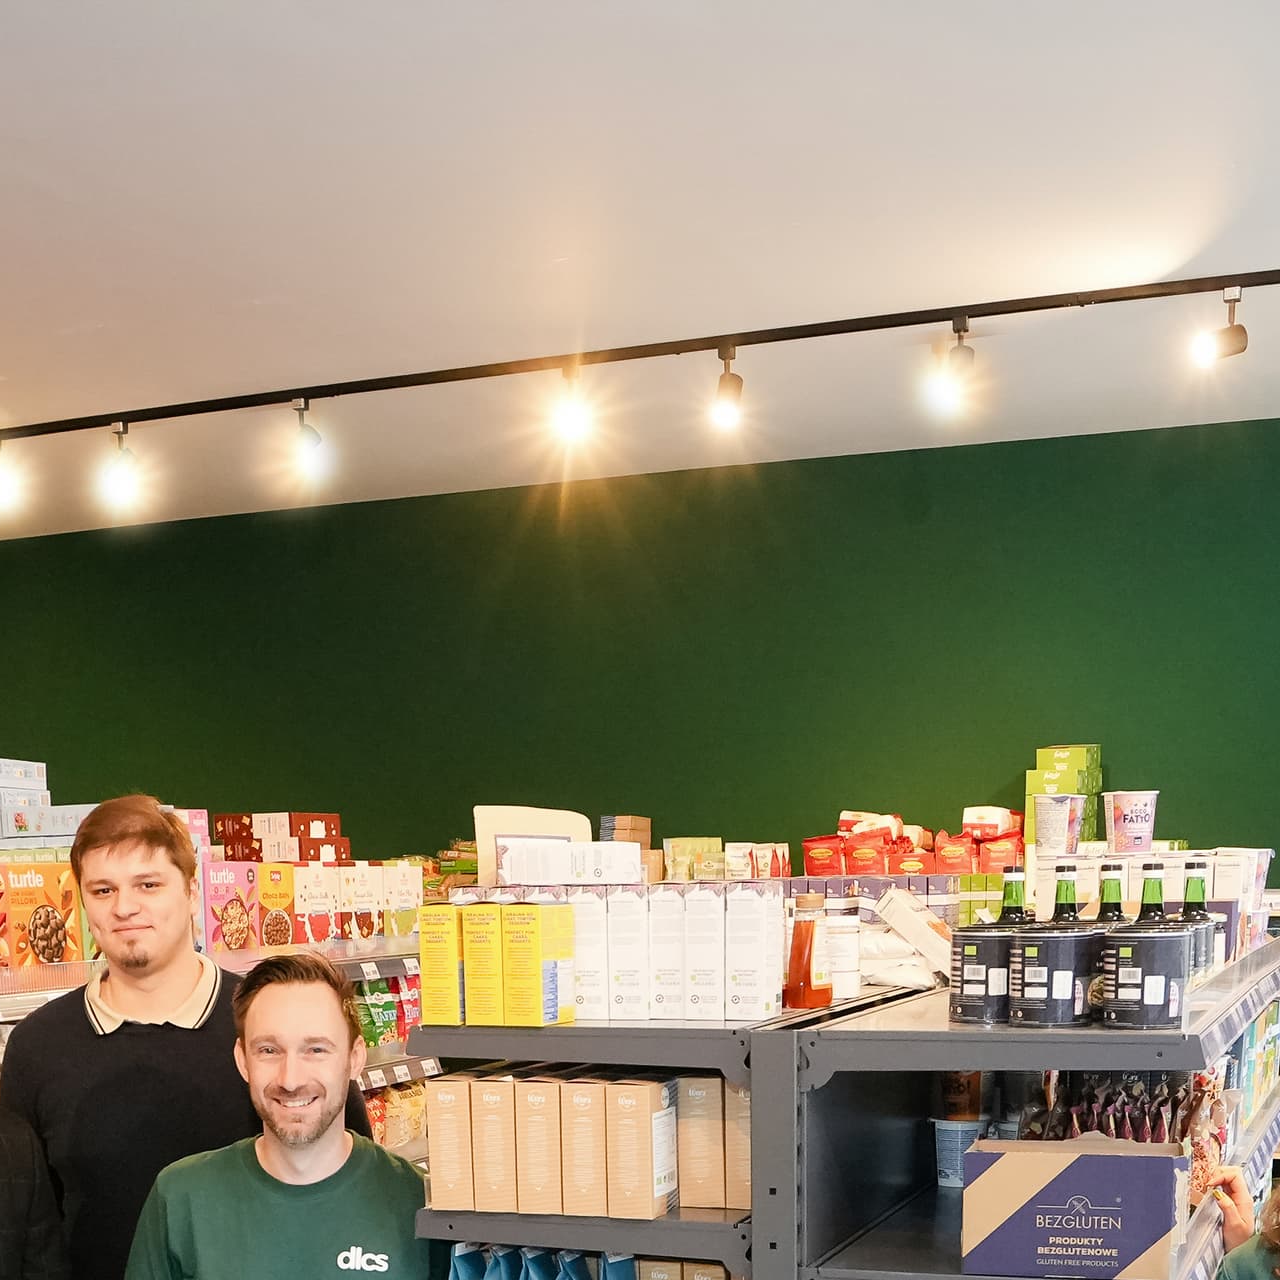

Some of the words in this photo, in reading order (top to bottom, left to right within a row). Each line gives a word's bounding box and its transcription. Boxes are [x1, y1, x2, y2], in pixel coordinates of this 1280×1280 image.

[8, 871, 44, 888] turtle
[210, 869, 235, 883] turtle
[1036, 1215, 1121, 1229] BEZGLUTEN
[1049, 1237, 1103, 1245] PRODUKTY
[1038, 1247, 1118, 1256] BEZGLUTENOWE
[337, 1246, 388, 1272] dlcs
[1082, 1259, 1118, 1267] PRODUCTS
